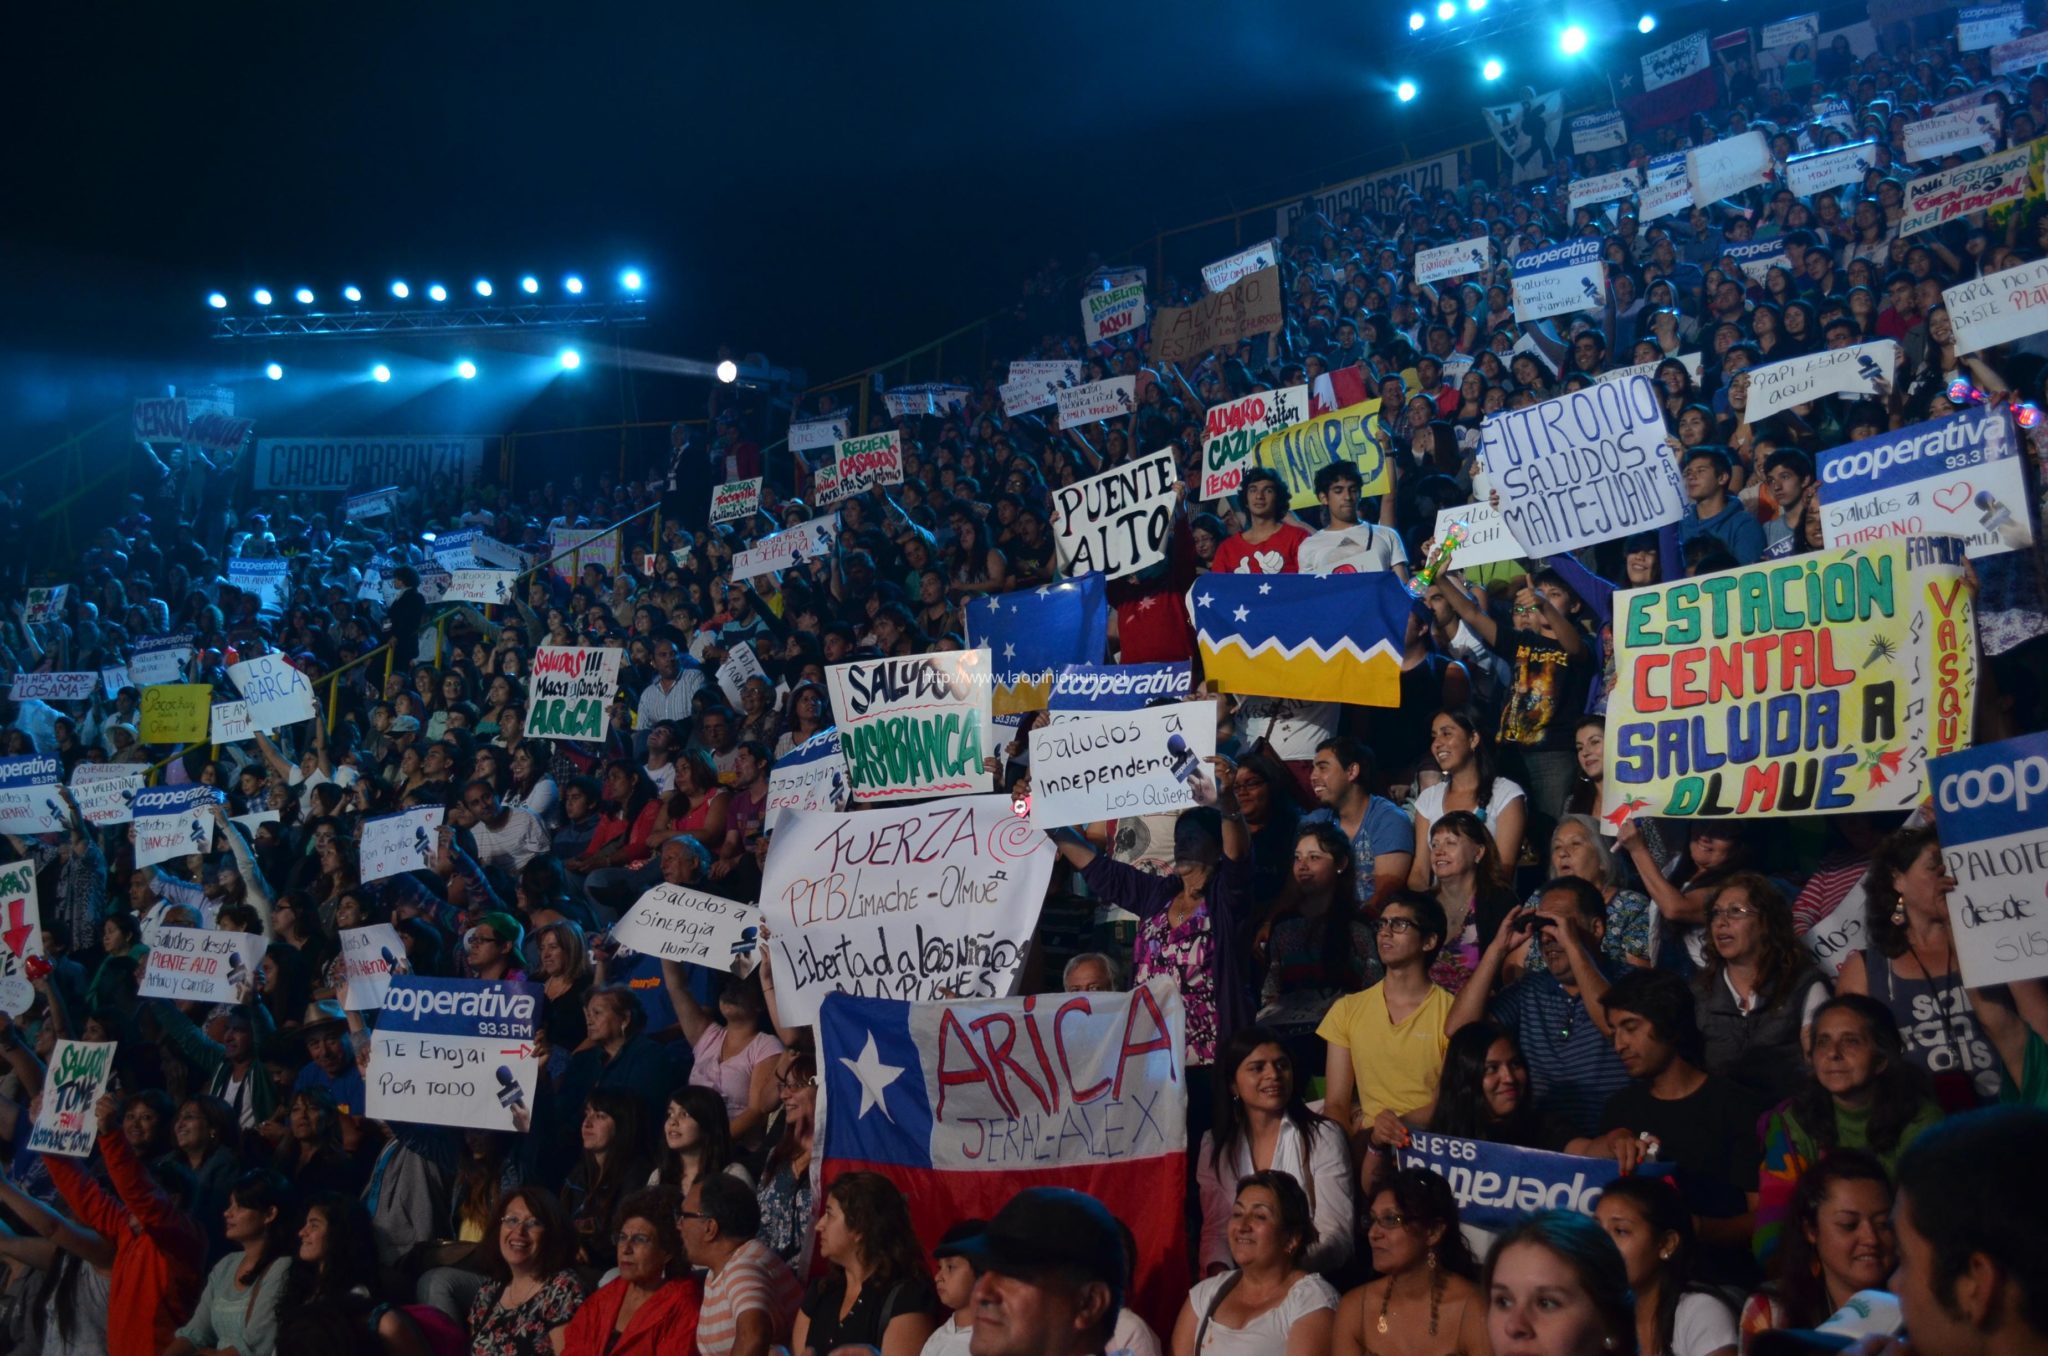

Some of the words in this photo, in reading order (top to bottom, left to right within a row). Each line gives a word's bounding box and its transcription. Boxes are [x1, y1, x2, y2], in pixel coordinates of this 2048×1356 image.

[1516, 239, 1600, 269] cooperativa
[1206, 397, 1265, 438] ALVARO
[839, 444, 899, 478] CASADOS
[842, 435, 891, 457] RECIEN
[1823, 413, 2005, 485] cooperativa
[1945, 449, 1981, 470] 93.3
[1983, 443, 2010, 461] FM
[1504, 431, 1646, 499] SALUDOS
[1058, 456, 1173, 537] PUENTE
[1206, 468, 1241, 498] PERO
[1831, 496, 1901, 528] Saludos
[1061, 505, 1169, 577] ALTO
[230, 560, 287, 571] cooperativa
[250, 658, 272, 679] LO
[848, 650, 980, 715] SALUDOS
[1056, 665, 1192, 702] cooperativa
[1633, 626, 1856, 713] CENTAL
[243, 669, 307, 707] ABARCA
[215, 705, 230, 721] TE
[234, 700, 248, 716] AM
[1037, 720, 1141, 763] Saludos
[1615, 689, 1841, 784] SALUDA
[1861, 680, 1896, 744] A
[1662, 743, 1859, 816] OLMUÉ
[815, 806, 979, 874] FUERZA
[653, 885, 727, 915] Saludos
[781, 872, 849, 927] PIB
[1960, 894, 2037, 930] desde
[153, 930, 195, 952] Saludos
[201, 936, 237, 954] desde
[781, 926, 893, 992] Libertad
[151, 951, 188, 973] PUENTE
[190, 958, 218, 976] ALTO
[478, 1022, 510, 1037] 93.3
[512, 1024, 532, 1038] FM
[379, 1039, 406, 1058] TE
[427, 1080, 476, 1098] TODO
[1430, 1136, 1477, 1161] 93.3
